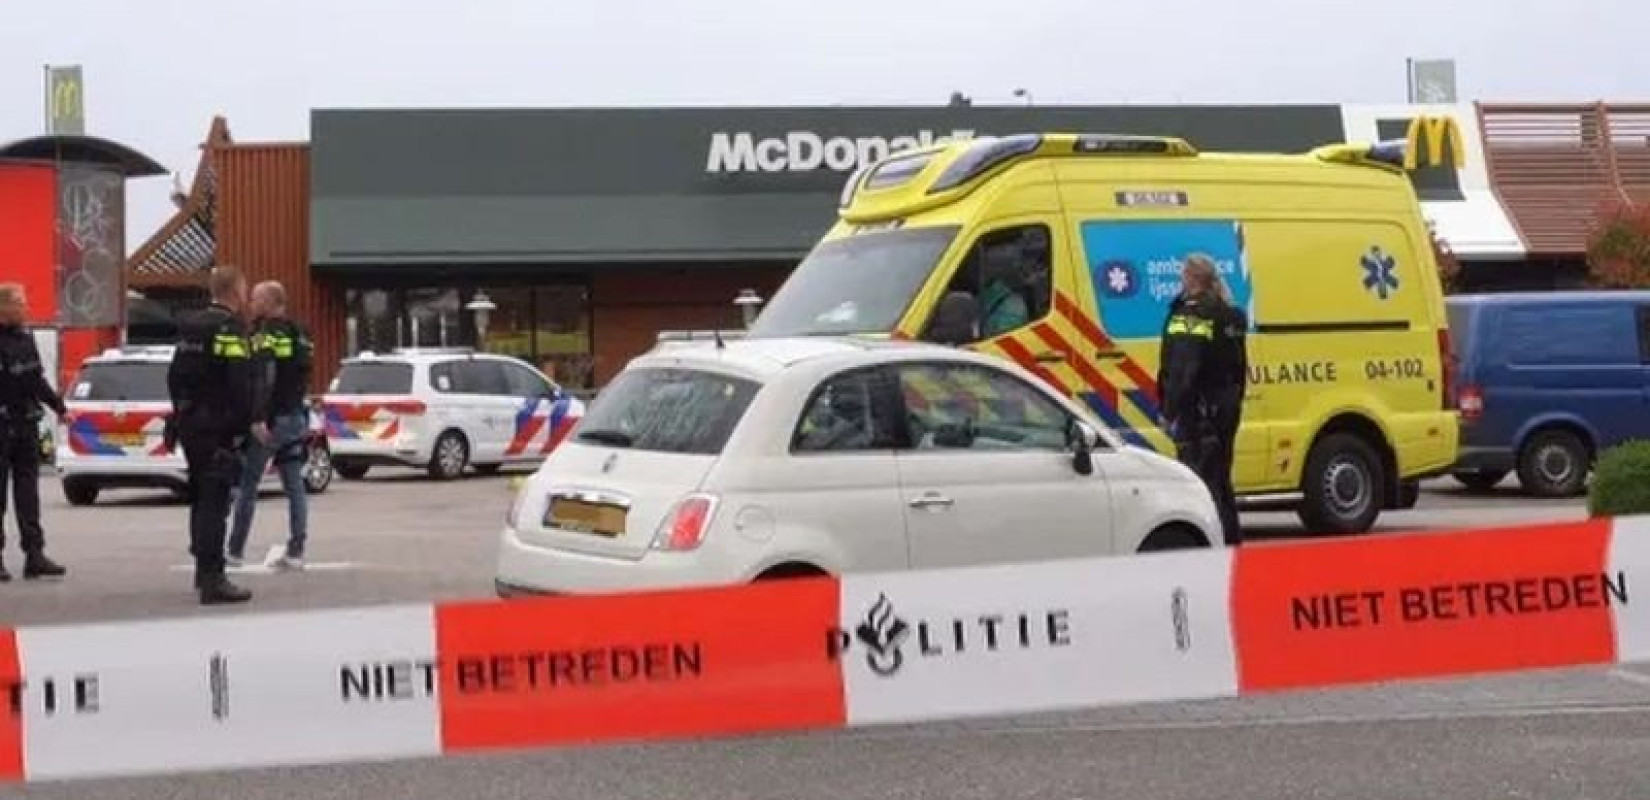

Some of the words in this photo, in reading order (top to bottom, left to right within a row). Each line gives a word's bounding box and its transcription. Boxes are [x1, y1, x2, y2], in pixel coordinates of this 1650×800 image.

[706, 129, 976, 172] McDon
[1404, 113, 1466, 169] M
[1249, 361, 1337, 385] ULANCE
[1364, 358, 1424, 379] 04-102
[1291, 591, 1385, 631] NIET
[1400, 570, 1629, 622] BETREDEN
[340, 660, 440, 701] NIET
[456, 641, 702, 695] BETREDEN
